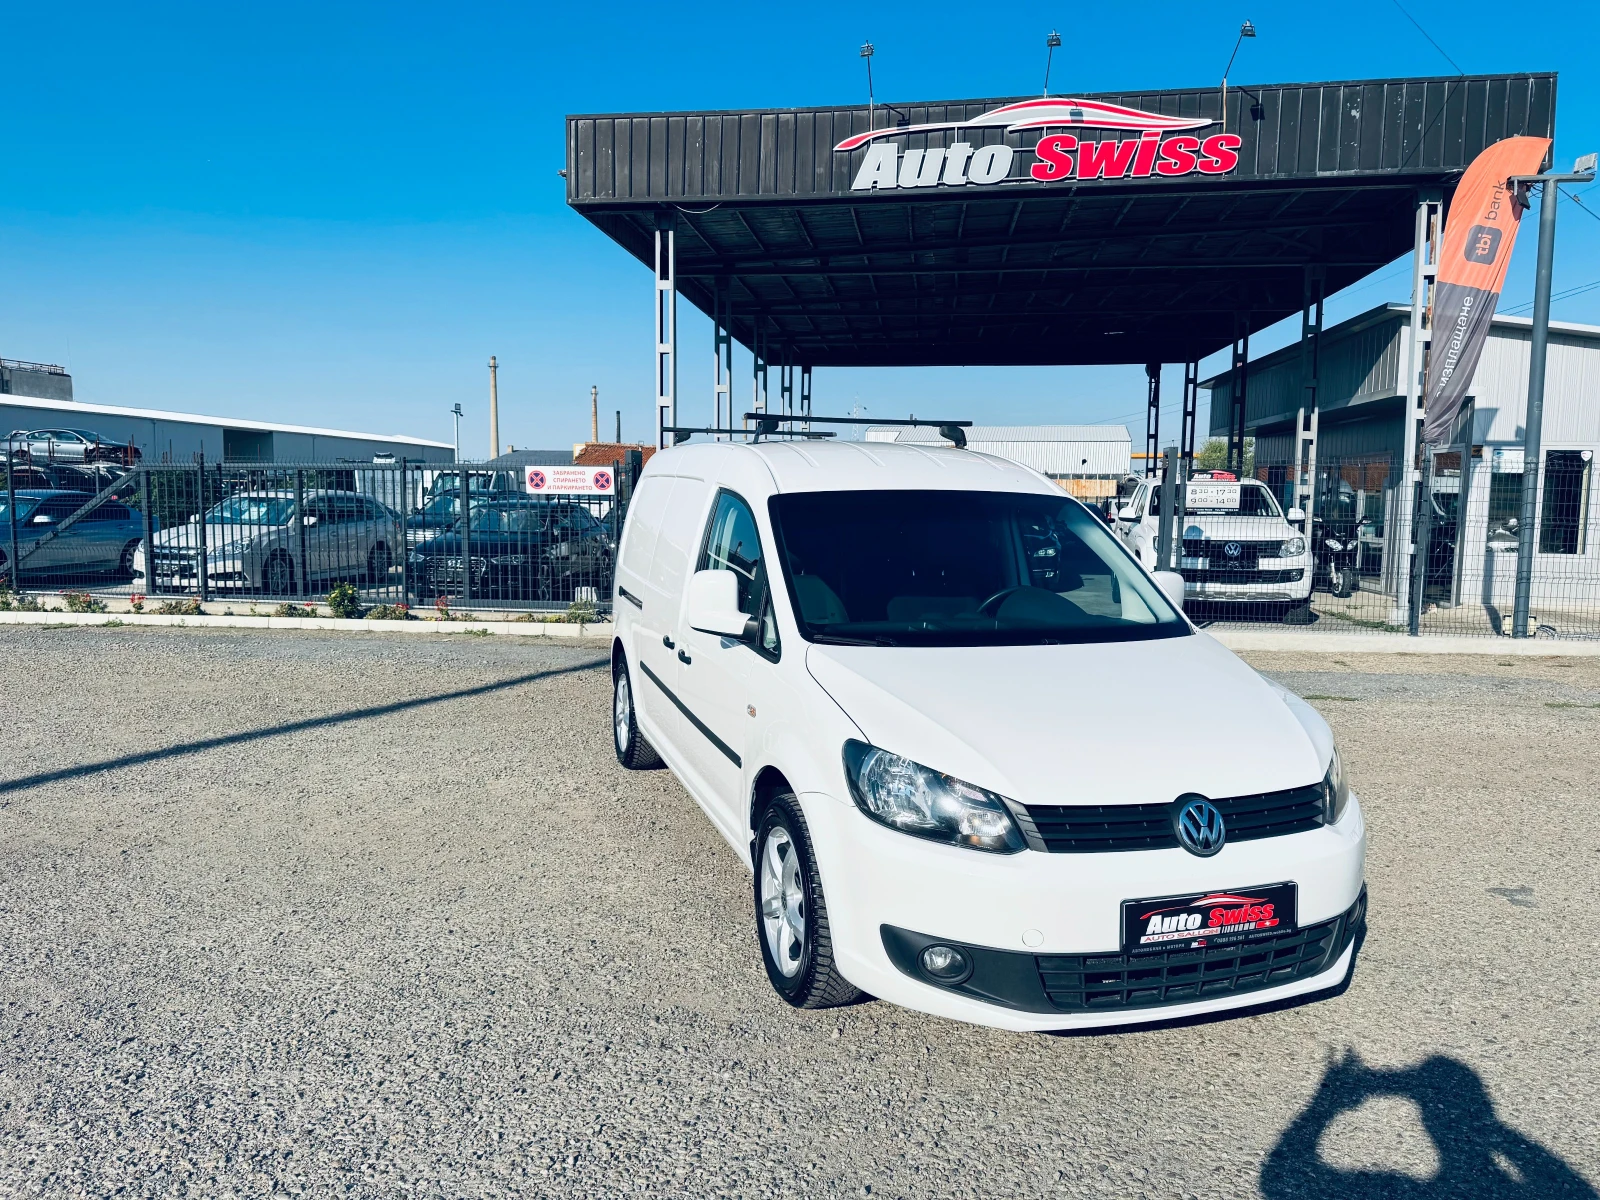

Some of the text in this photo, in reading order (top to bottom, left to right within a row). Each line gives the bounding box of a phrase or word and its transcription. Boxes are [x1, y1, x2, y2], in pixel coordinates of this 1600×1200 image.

[851, 130, 1241, 191] Auto Swiss
[1484, 180, 1506, 221] bank
[1475, 233, 1492, 256] tbi
[1146, 904, 1275, 935] Auto Swiss
[1144, 929, 1219, 942] AUTO SALLON
